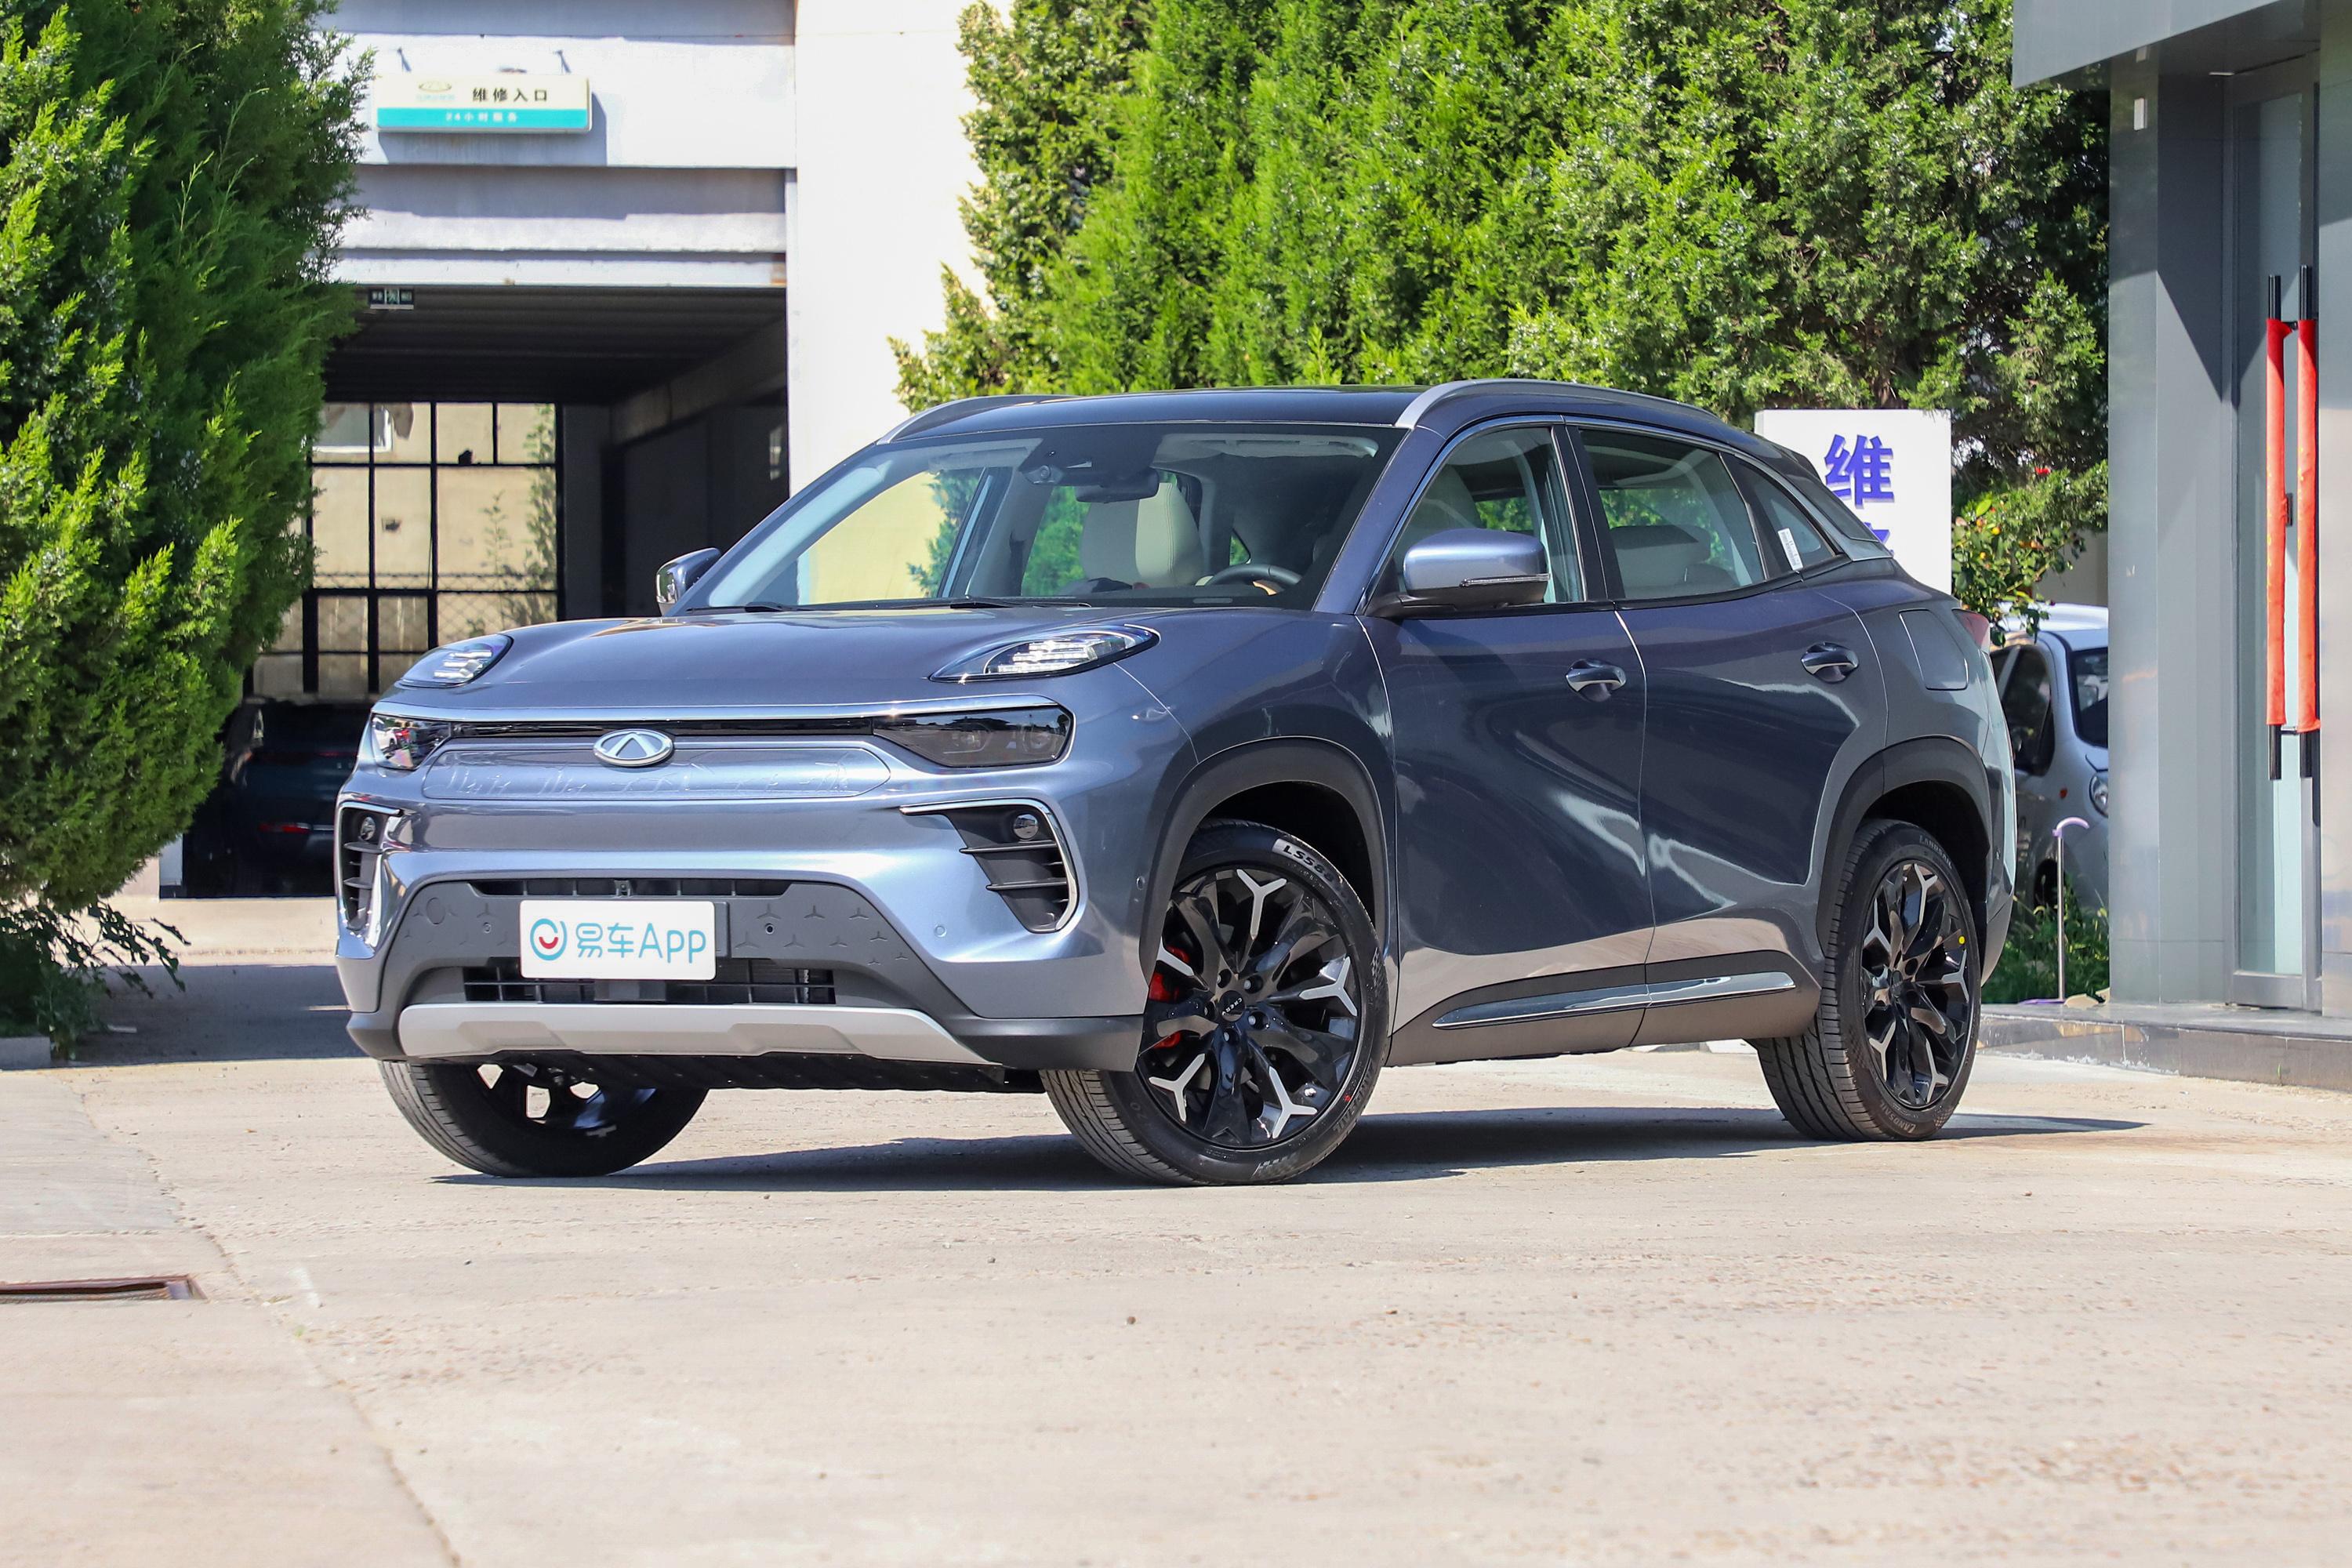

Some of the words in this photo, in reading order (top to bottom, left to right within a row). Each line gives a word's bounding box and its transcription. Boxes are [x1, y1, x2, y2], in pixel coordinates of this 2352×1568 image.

[472, 87, 547, 103] 维修入口
[575, 922, 706, 964] 易车App
[1878, 1100, 1917, 1134] LANDSAIL
